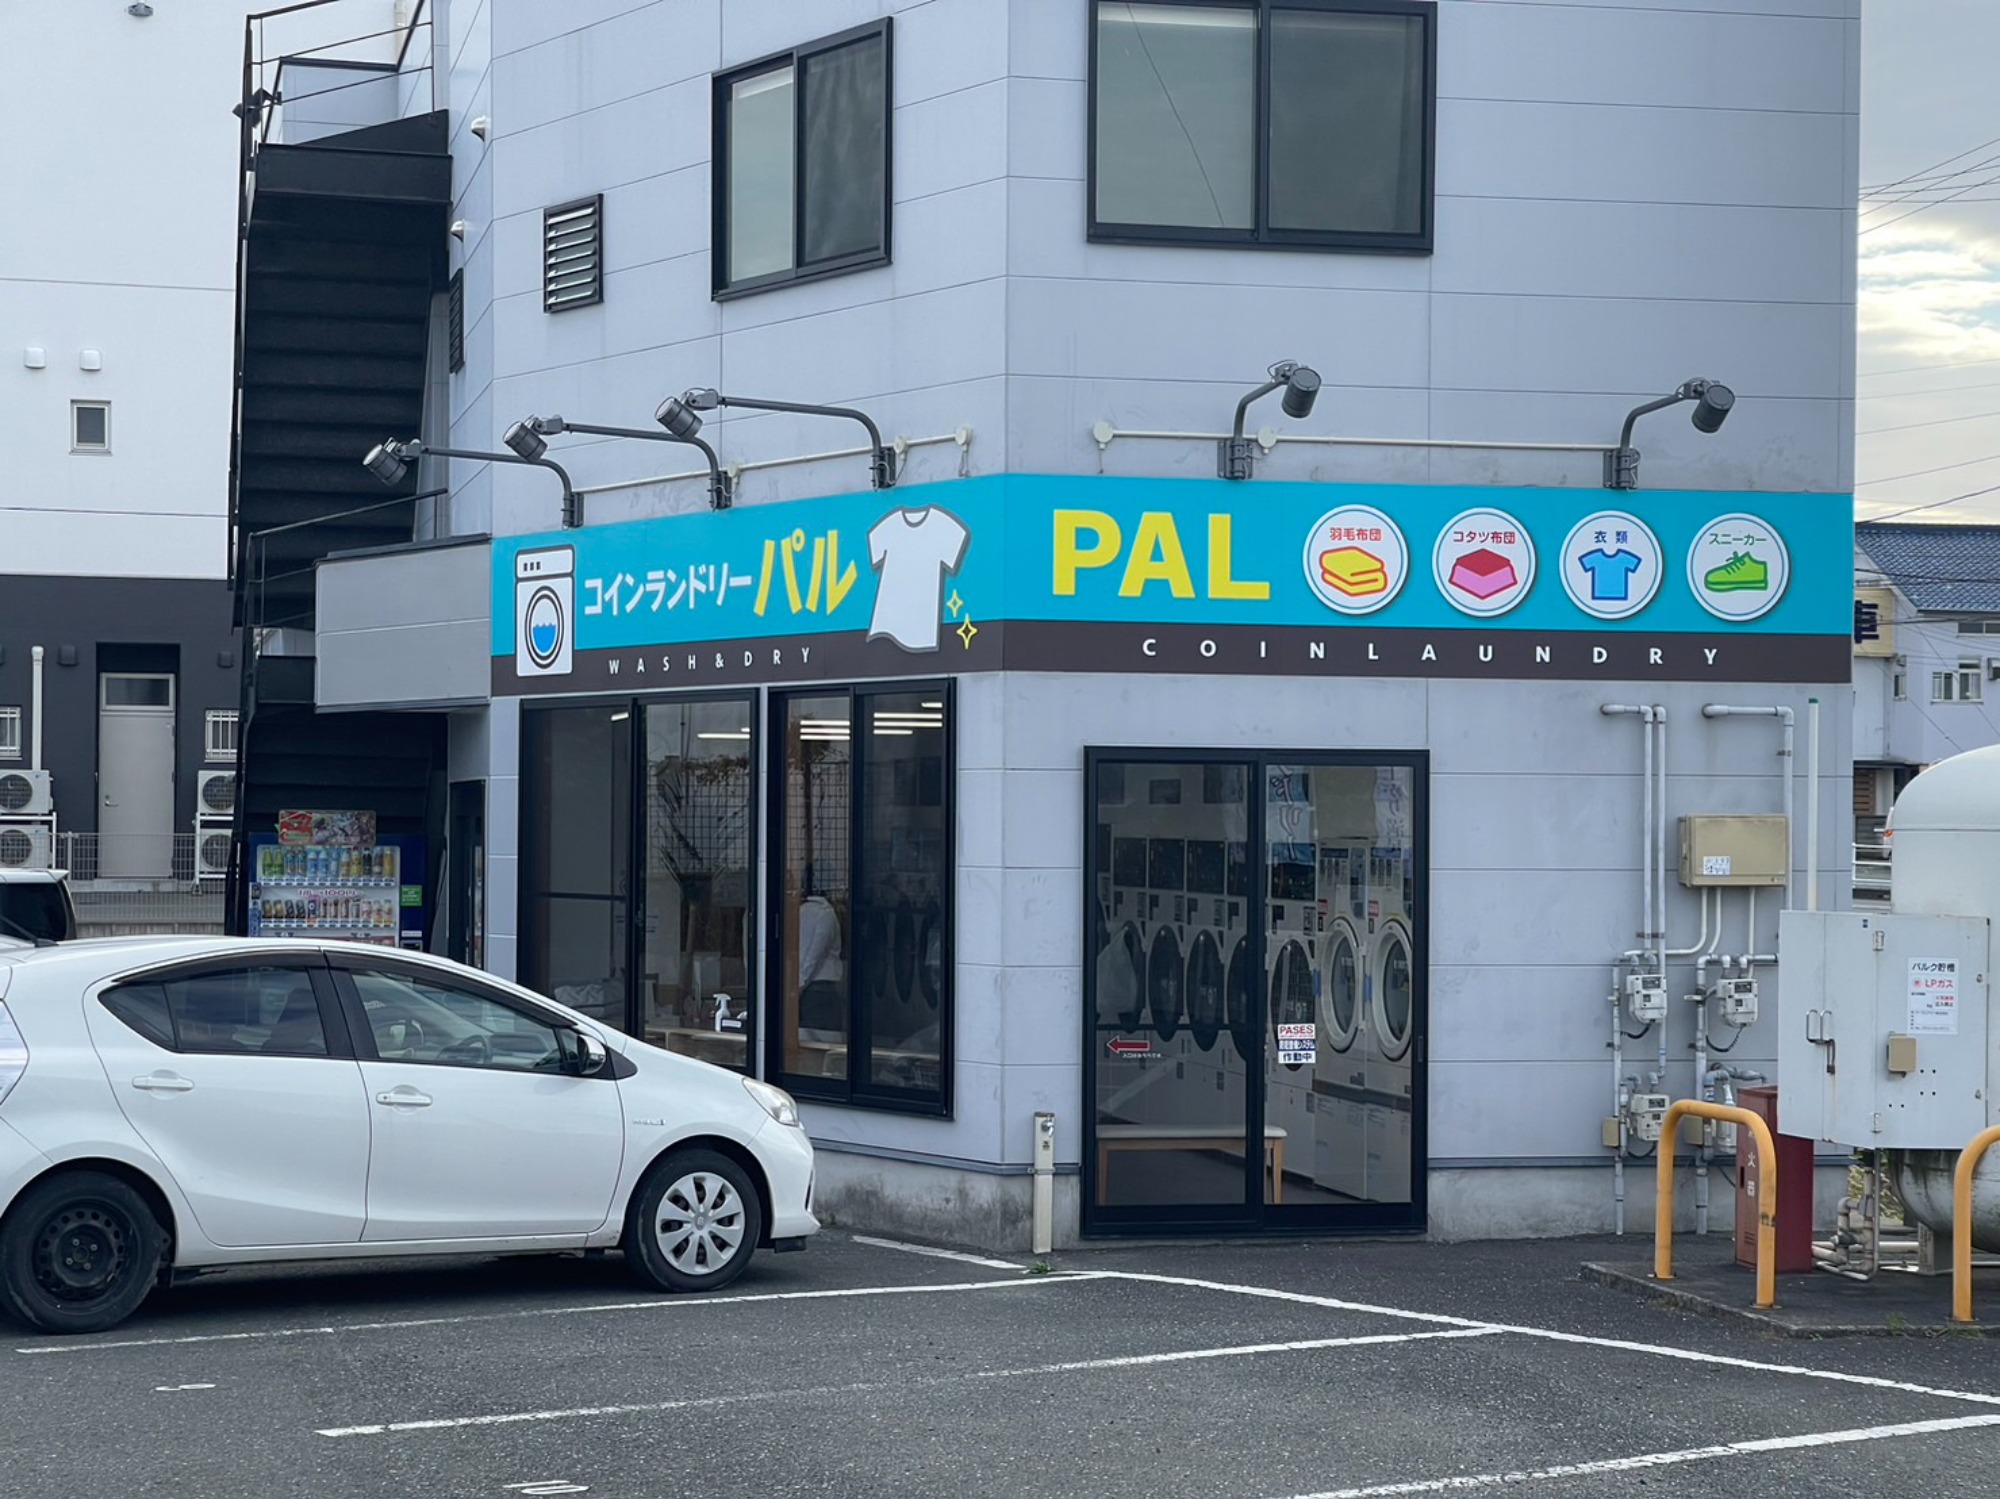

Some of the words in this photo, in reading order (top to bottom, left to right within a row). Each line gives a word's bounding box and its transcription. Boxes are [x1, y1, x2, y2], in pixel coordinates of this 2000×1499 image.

[1329, 527, 1382, 542] 羽毛布団
[1453, 530, 1516, 545] コタツ布団
[1594, 530, 1629, 545] 衣類
[1708, 533, 1767, 546] スニーカー
[1053, 509, 1271, 600] PAL
[584, 562, 752, 616] コインランドリー
[753, 528, 858, 617] パル
[1279, 1025, 1314, 1035] PASES
